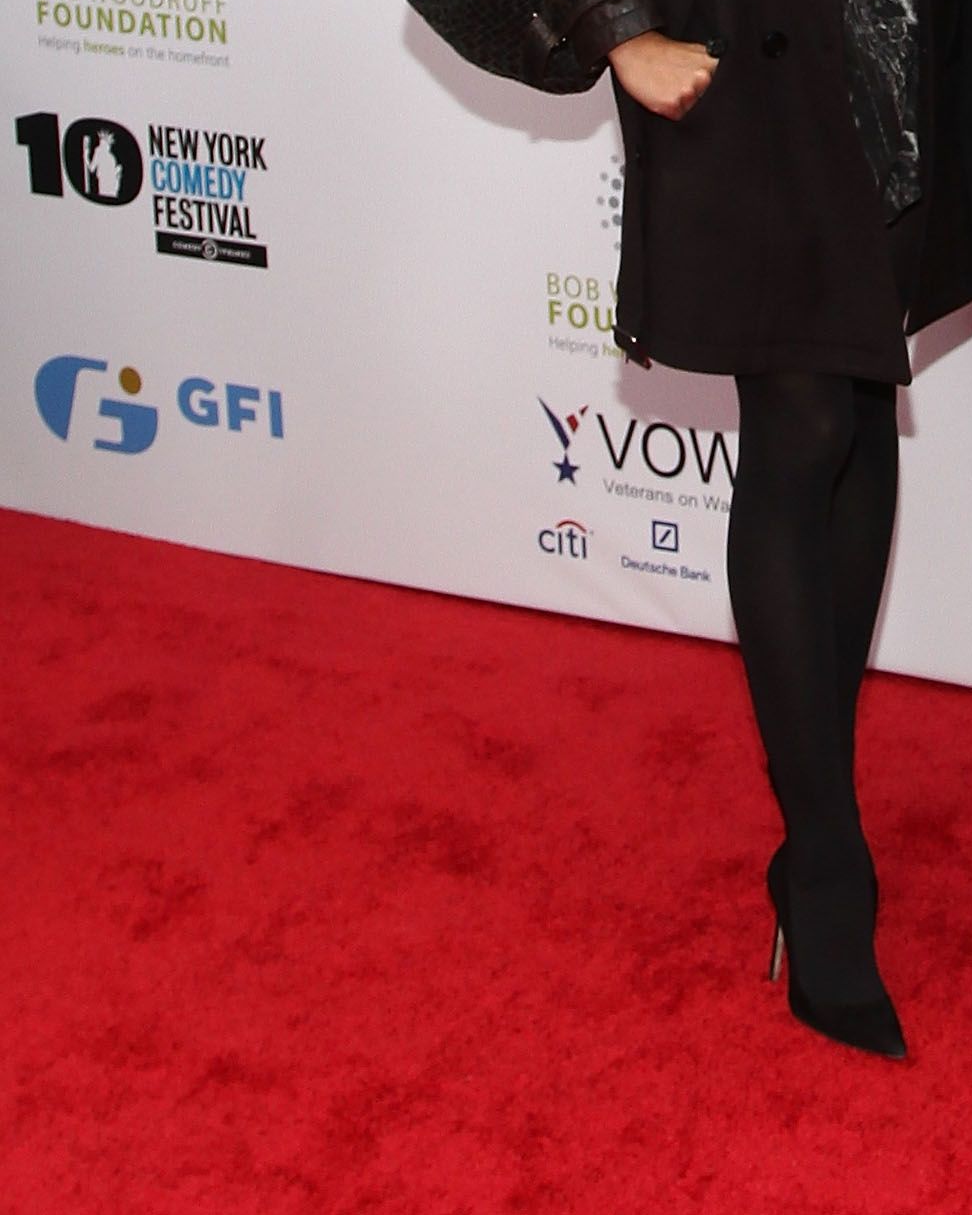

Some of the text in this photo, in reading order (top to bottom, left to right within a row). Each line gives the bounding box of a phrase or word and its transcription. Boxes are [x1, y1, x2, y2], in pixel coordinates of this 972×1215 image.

[36, 1, 228, 45] FOUNDATION
[38, 36, 81, 55] Helping
[128, 45, 143, 58] on
[146, 45, 165, 60] the
[15, 112, 143, 206] 10
[149, 123, 267, 171] NEW YORK
[151, 159, 246, 202] COMEDY
[153, 195, 257, 239] FESTIVAL
[547, 272, 599, 301] BOB
[549, 337, 598, 359] Helping
[177, 377, 284, 439] GFI
[603, 479, 675, 504] Veterans
[679, 491, 698, 506] on
[538, 527, 587, 559] citi
[621, 556, 711, 582] Deutsche Bank
